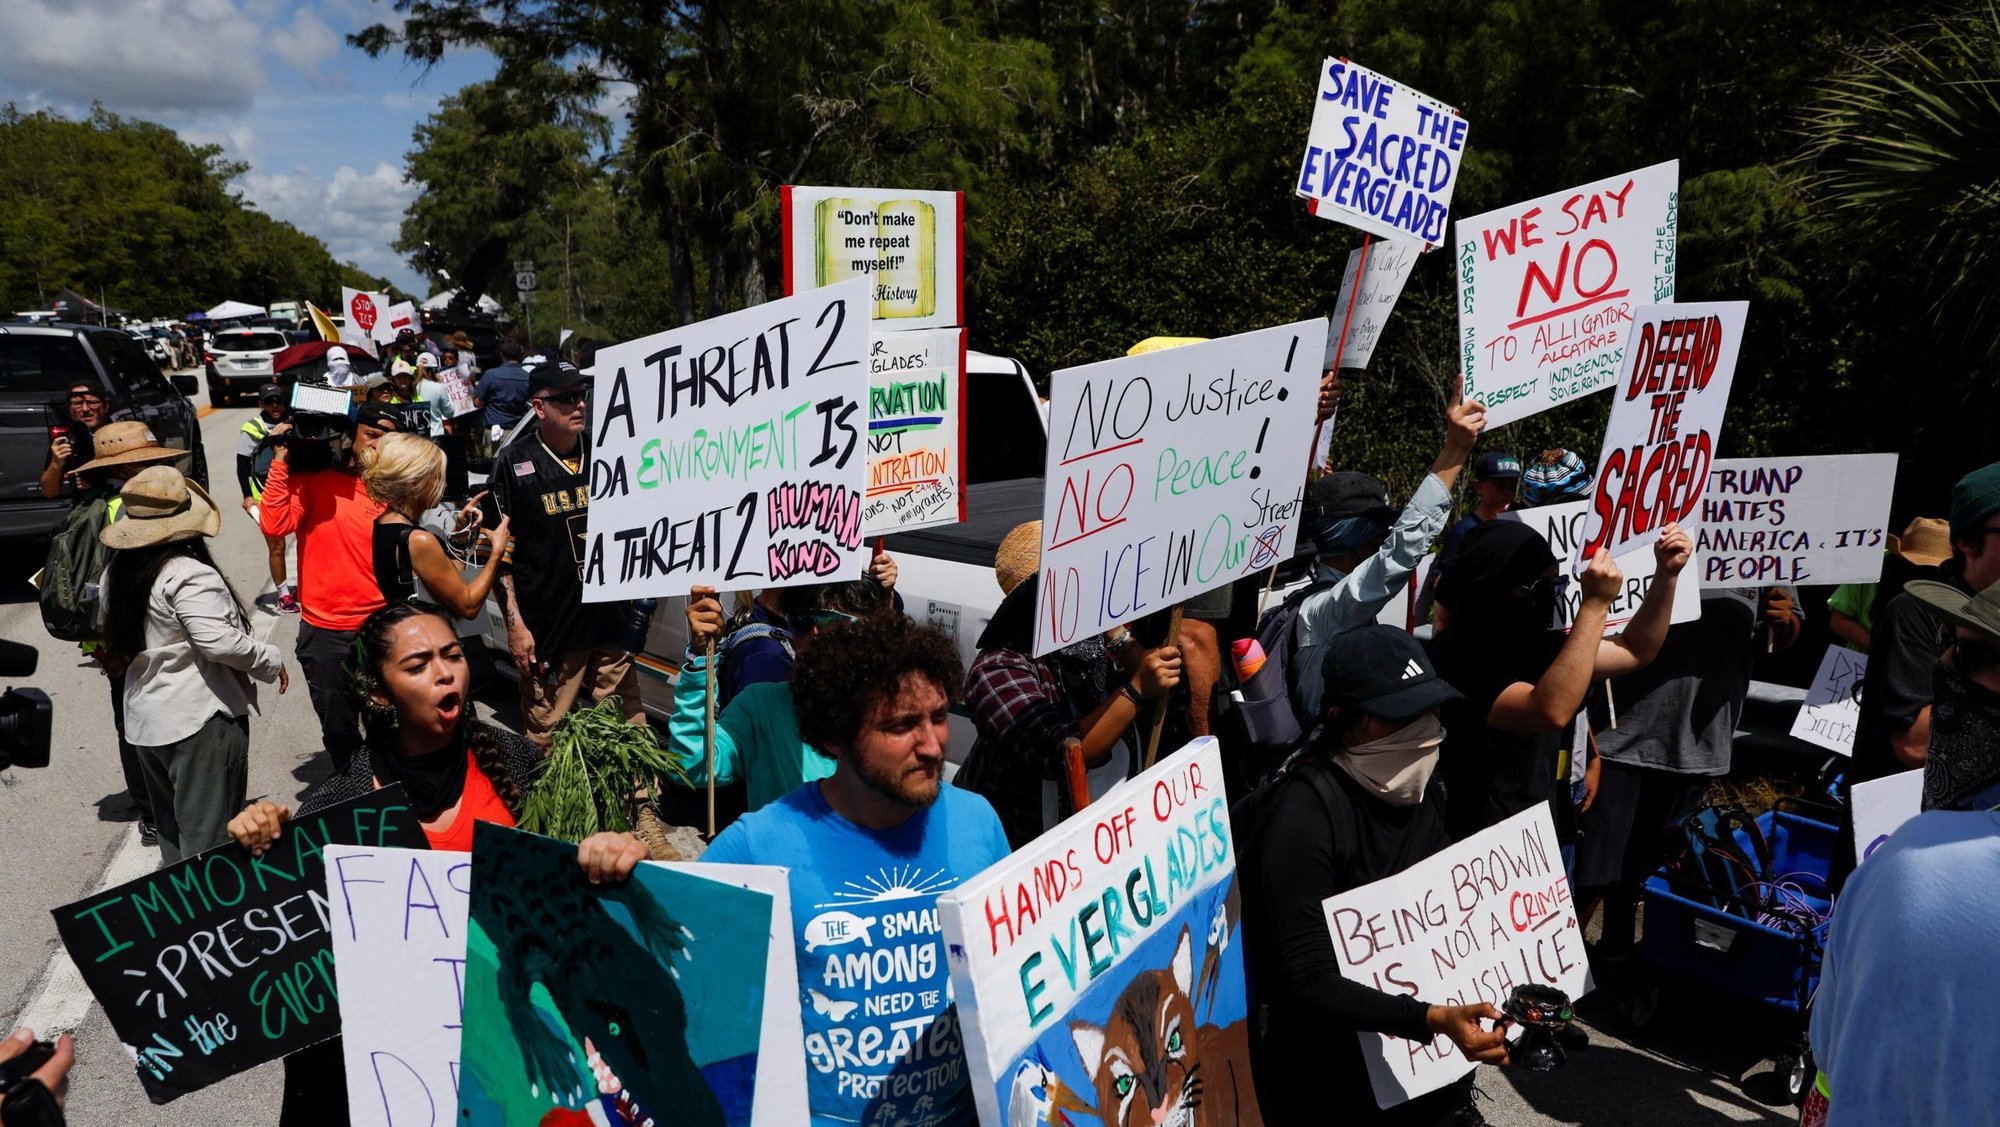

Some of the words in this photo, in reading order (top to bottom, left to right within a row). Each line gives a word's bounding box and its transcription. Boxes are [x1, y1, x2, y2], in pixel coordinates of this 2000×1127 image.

[1321, 63, 1394, 120] SAVE
[1416, 103, 1467, 151] THE
[1334, 116, 1452, 193] SACRED
[882, 211, 916, 227] make
[1300, 146, 1448, 242] EVERGLADES
[1482, 206, 1544, 262] WE
[1556, 178, 1635, 236] SAY
[845, 237, 866, 248] me
[870, 234, 910, 252] repeat
[1654, 226, 1666, 265] THE
[1663, 191, 1679, 298] EVERGLADES
[519, 275, 533, 287] 41
[1461, 240, 1476, 315] RESPECT
[1516, 238, 1618, 318] NO
[358, 312, 373, 326] ICE
[871, 341, 888, 357] UR
[1485, 335, 1518, 371] TO
[1531, 302, 1633, 353] ALLIGATOR
[1537, 330, 1617, 369] ALCATRAZ
[596, 366, 636, 447] A
[644, 317, 802, 424] THREAT
[806, 299, 862, 377] 2
[870, 348, 928, 374] GLADES!
[1463, 326, 1475, 396] MIGRANTS
[1473, 378, 1539, 409] RESPECT
[1549, 347, 1624, 386] INDIGENOUS
[1625, 312, 1723, 402] DEFEND
[871, 376, 947, 420] RVATION
[1063, 376, 1153, 461] NO
[1166, 335, 1299, 422] Justice!
[1646, 391, 1687, 447] THE
[590, 455, 630, 501] DA
[636, 401, 812, 490] ENVIRONMENT
[809, 395, 859, 470] IS
[867, 429, 907, 455] NOT
[870, 447, 947, 487] NTRATION
[891, 489, 914, 513] NOT
[898, 475, 956, 526] immigrants!
[1052, 463, 1135, 544] NO
[1155, 417, 1271, 502] Peace!
[1243, 486, 1303, 529] Street
[1581, 426, 1712, 561] SACRED
[1702, 498, 1786, 526] HATES
[1706, 465, 1803, 497] TRUMP
[585, 532, 606, 587] A
[614, 505, 734, 584] THREAT
[724, 492, 763, 581] 2
[767, 480, 864, 552] HUMAN
[1696, 528, 1810, 554] AMERICA
[767, 539, 841, 582] KIND
[1035, 566, 1080, 658] NO
[1098, 535, 1156, 627] ICE
[1161, 529, 1196, 599] IN
[1197, 513, 1251, 584] Our
[1705, 554, 1811, 584] PEOPLE
[1802, 704, 1856, 744] Sacre
[984, 848, 1083, 957] HANDS
[1094, 807, 1138, 865] OFF
[1153, 762, 1209, 822] OUR
[821, 920, 850, 937] THE
[882, 909, 942, 939] SMAL
[1019, 796, 1228, 1029] EVERGLADES
[1333, 889, 1448, 966] BEING
[1450, 820, 1551, 912] BROWN
[156, 888, 333, 999] PRESEN
[1373, 962, 1419, 999] IS
[1431, 910, 1480, 980] NOT
[1491, 912, 1510, 950] A
[184, 1011, 238, 1056] the
[249, 948, 339, 1040] Ever
[865, 992, 914, 1017] NEED
[917, 990, 940, 1009] THE
